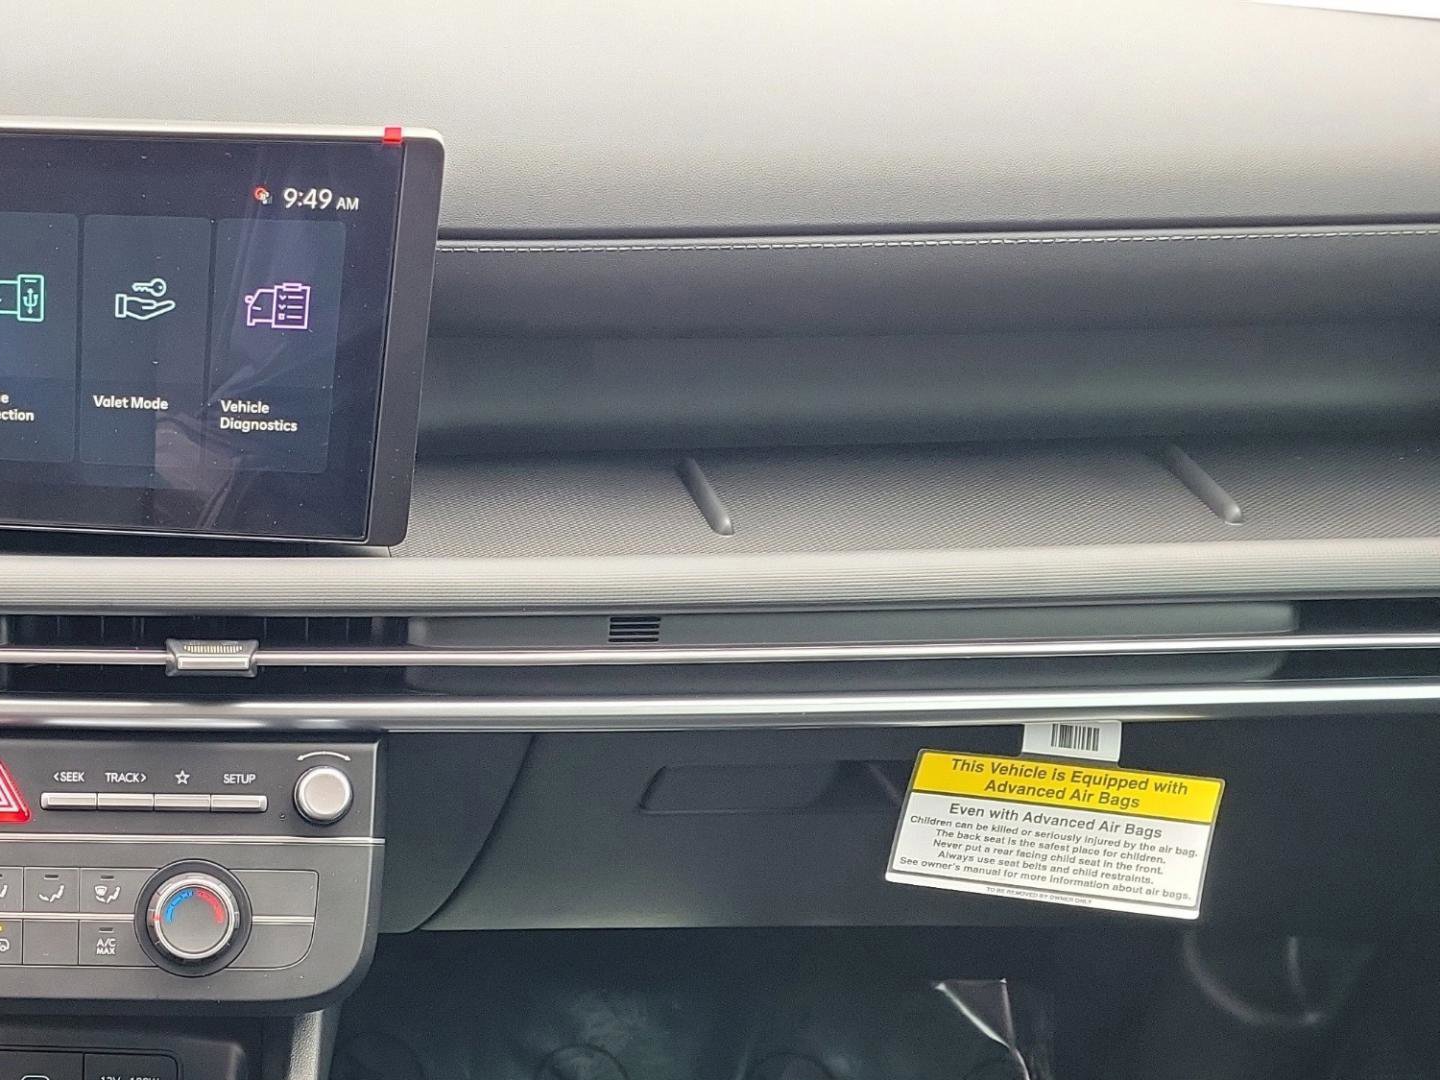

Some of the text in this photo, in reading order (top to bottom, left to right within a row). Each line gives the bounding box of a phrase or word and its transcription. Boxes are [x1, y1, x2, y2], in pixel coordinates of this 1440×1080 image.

[284, 187, 360, 210] 9:49 AM
[93, 395, 169, 411] Valet Mode
[220, 400, 270, 415] Vehicle
[219, 417, 298, 433] Diagnostics
[223, 773, 257, 785] SETUP
[951, 758, 1188, 795] This Vehicle is Equipped with
[984, 779, 1140, 810] Advanced Air Bags
[910, 815, 952, 827] Children
[955, 822, 973, 830] can
[975, 823, 988, 831] be
[991, 825, 1018, 835] killed
[1034, 831, 1082, 844] seriously
[1084, 835, 1121, 848] injured
[1123, 838, 1136, 850] by
[1139, 841, 1156, 851] the
[1159, 845, 1173, 854] air
[1175, 846, 1198, 858] bag.
[949, 803, 1162, 839] Even with Advanced Air Bags
[933, 839, 962, 850] Never
[965, 844, 982, 854] put
[993, 848, 1013, 856] rear
[1016, 849, 1048, 861] facing
[1050, 854, 1076, 864] child
[1078, 858, 1100, 868] seat
[1103, 860, 1112, 869] in
[1116, 861, 1133, 871] the
[1135, 864, 1164, 876] front.
[936, 829, 1166, 864] The back seat is the safest place for children.
[900, 856, 1192, 901] See owner's manual for more information about air bags.
[937, 850, 974, 863] Always
[998, 858, 1020, 868] seat
[1022, 861, 1047, 872] belts
[1050, 865, 1070, 874] and
[1072, 867, 1098, 878] child
[1100, 871, 1154, 885] restraints.
[96, 937, 116, 948] A/C
[96, 945, 116, 955] MAX
